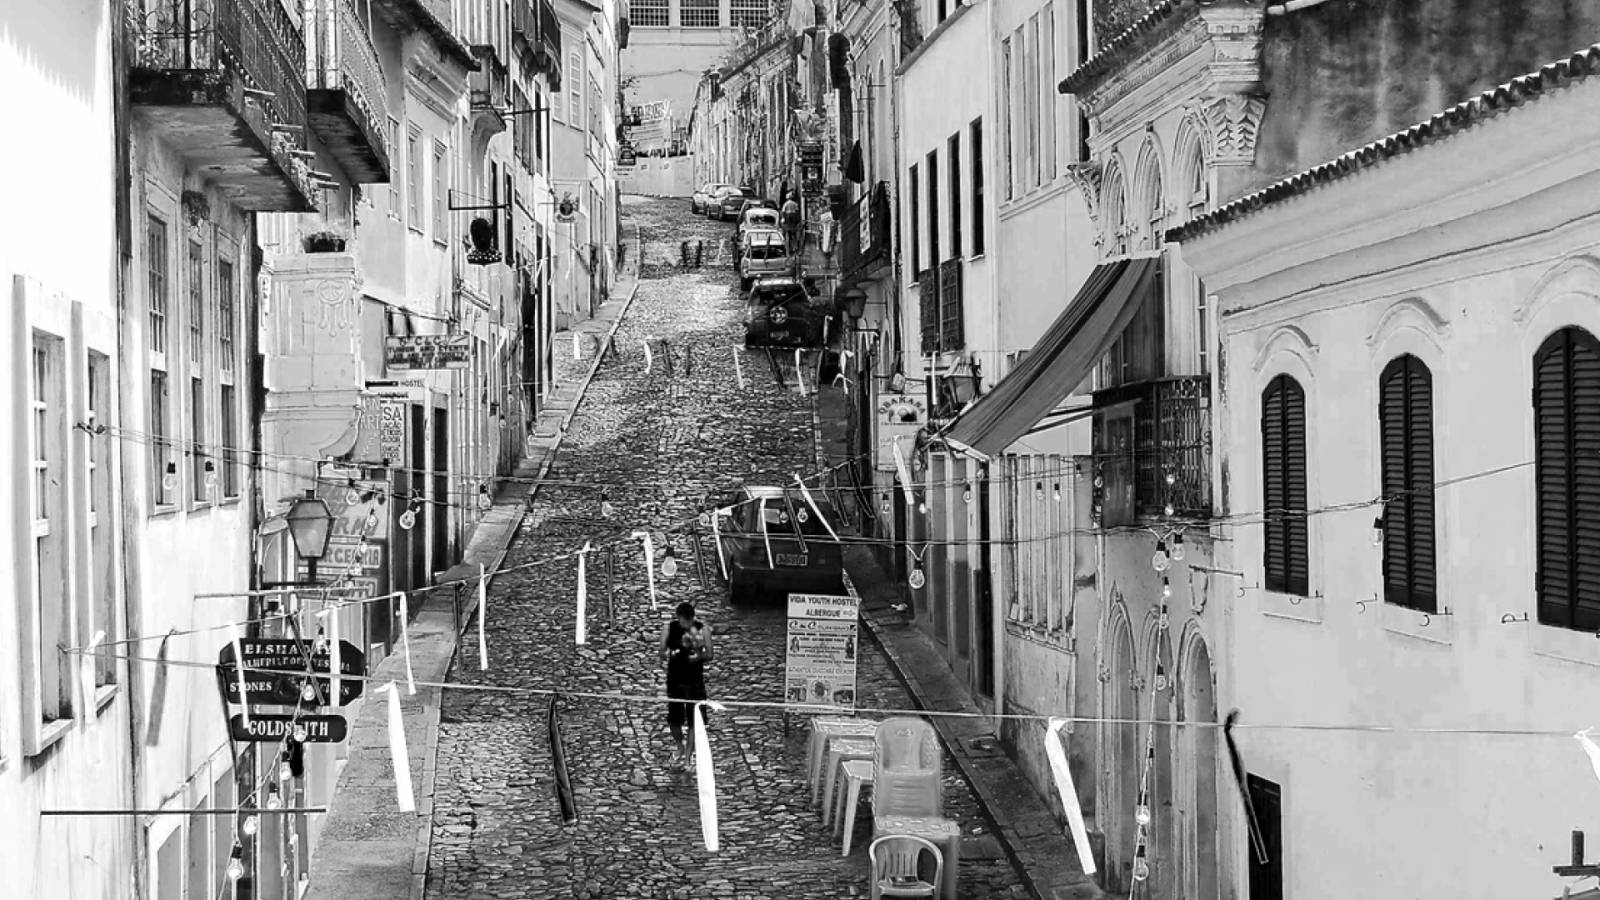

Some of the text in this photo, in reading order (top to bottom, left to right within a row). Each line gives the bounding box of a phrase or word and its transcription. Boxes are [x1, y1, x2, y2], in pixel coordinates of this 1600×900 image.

[808, 597, 831, 605] YOUTH
[833, 599, 858, 607] HOSTEL
[805, 609, 841, 617] ALBERGUE
[248, 720, 329, 736] GOLDSITH
